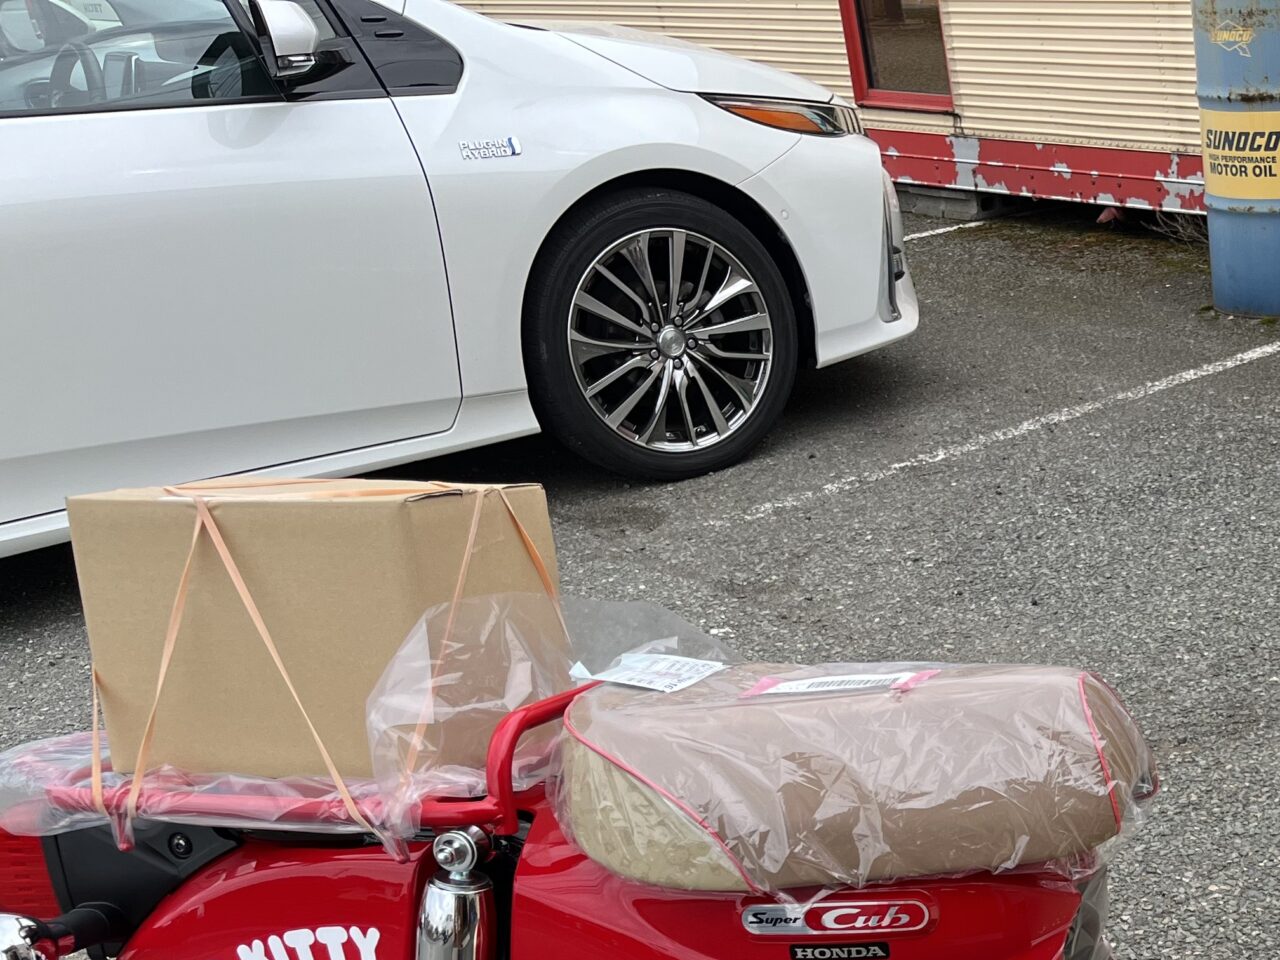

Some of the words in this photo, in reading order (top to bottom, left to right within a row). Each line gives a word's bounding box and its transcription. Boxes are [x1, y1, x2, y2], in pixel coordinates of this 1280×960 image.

[1210, 29, 1251, 42] SUNOCO
[458, 139, 507, 150] PLUG-IN
[461, 149, 511, 160] HYBRID
[1221, 155, 1277, 164] PERFORMANCE
[1210, 161, 1248, 178] MOTOR
[1252, 165, 1277, 178] OIL
[749, 912, 801, 927] Super
[821, 906, 910, 929] Cub
[794, 946, 887, 960] HONDA
